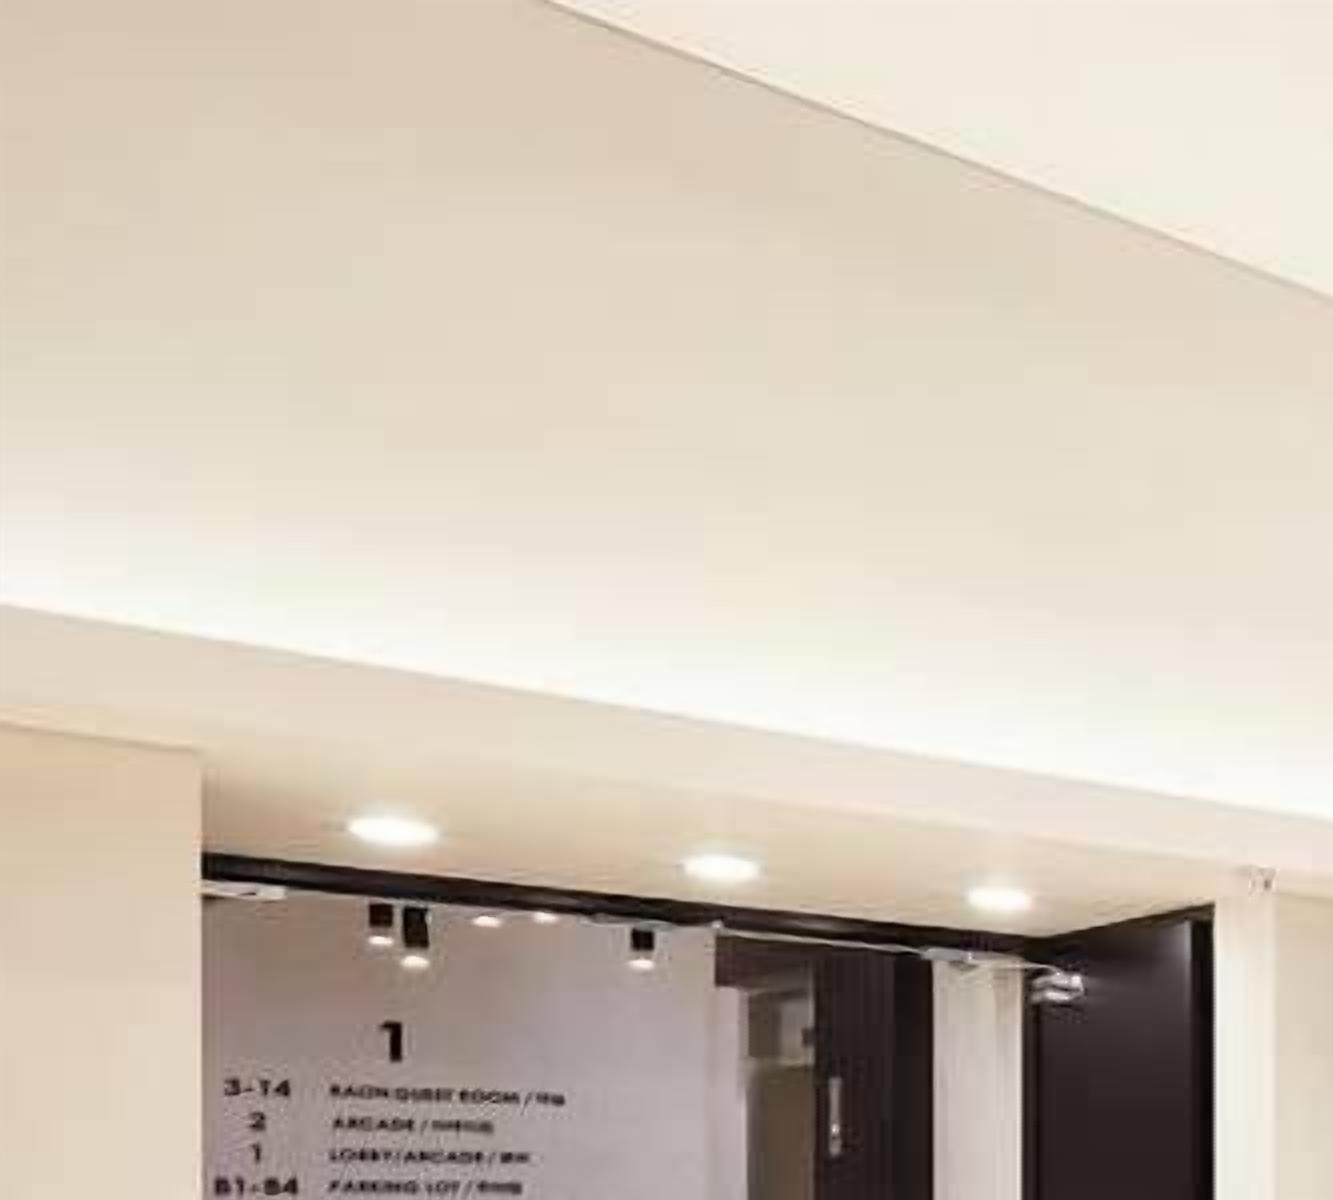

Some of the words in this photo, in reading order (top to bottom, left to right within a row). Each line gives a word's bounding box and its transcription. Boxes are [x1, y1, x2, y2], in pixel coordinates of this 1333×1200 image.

[379, 1020, 403, 1063] 1
[223, 1078, 291, 1098] 3-14
[249, 1112, 266, 1132] 2
[332, 1117, 414, 1132] ARCADE
[250, 1142, 261, 1165] 1
[214, 1175, 299, 1197] B1-B4
[328, 1178, 419, 1196] PARKING
